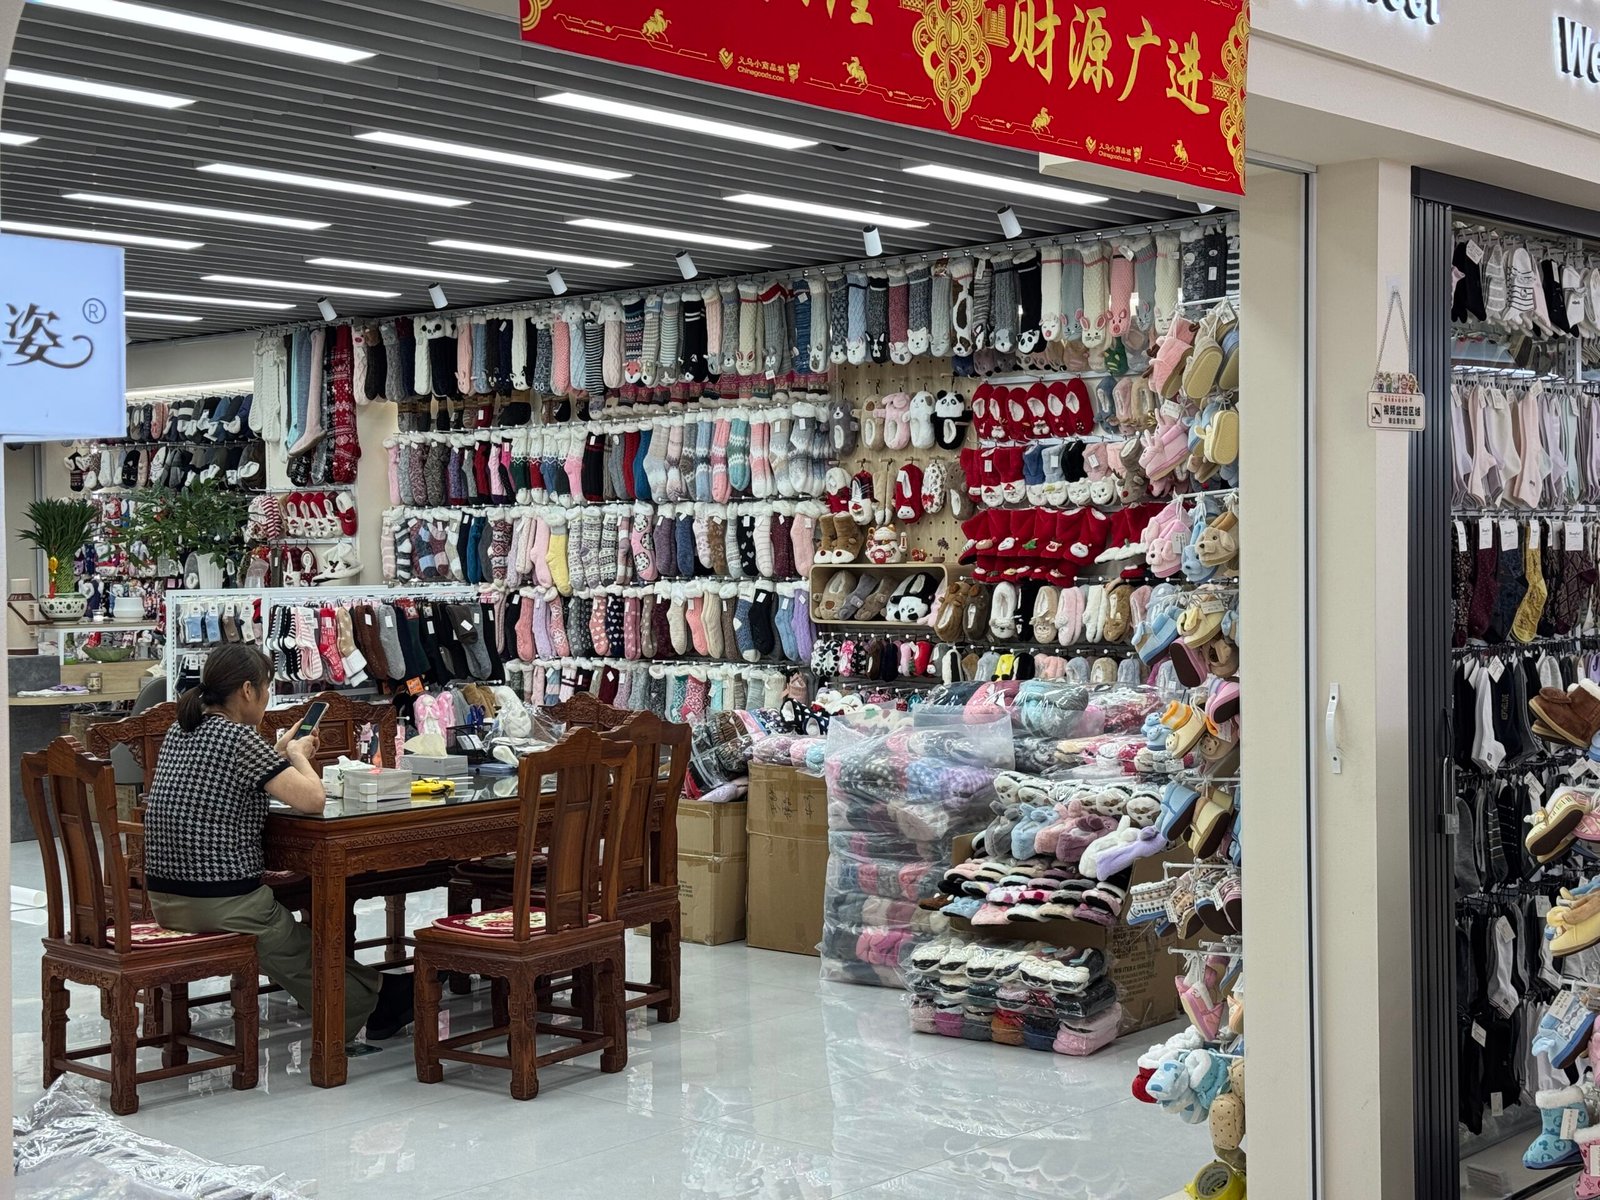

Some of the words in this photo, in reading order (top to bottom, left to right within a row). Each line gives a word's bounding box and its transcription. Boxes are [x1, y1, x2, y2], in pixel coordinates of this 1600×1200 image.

[737, 65, 785, 82] Chinagoods.com
[738, 56, 785, 74] 义乌小商品城
[1008, 0, 1210, 114] 财源广进
[0, 303, 94, 369] 姿
